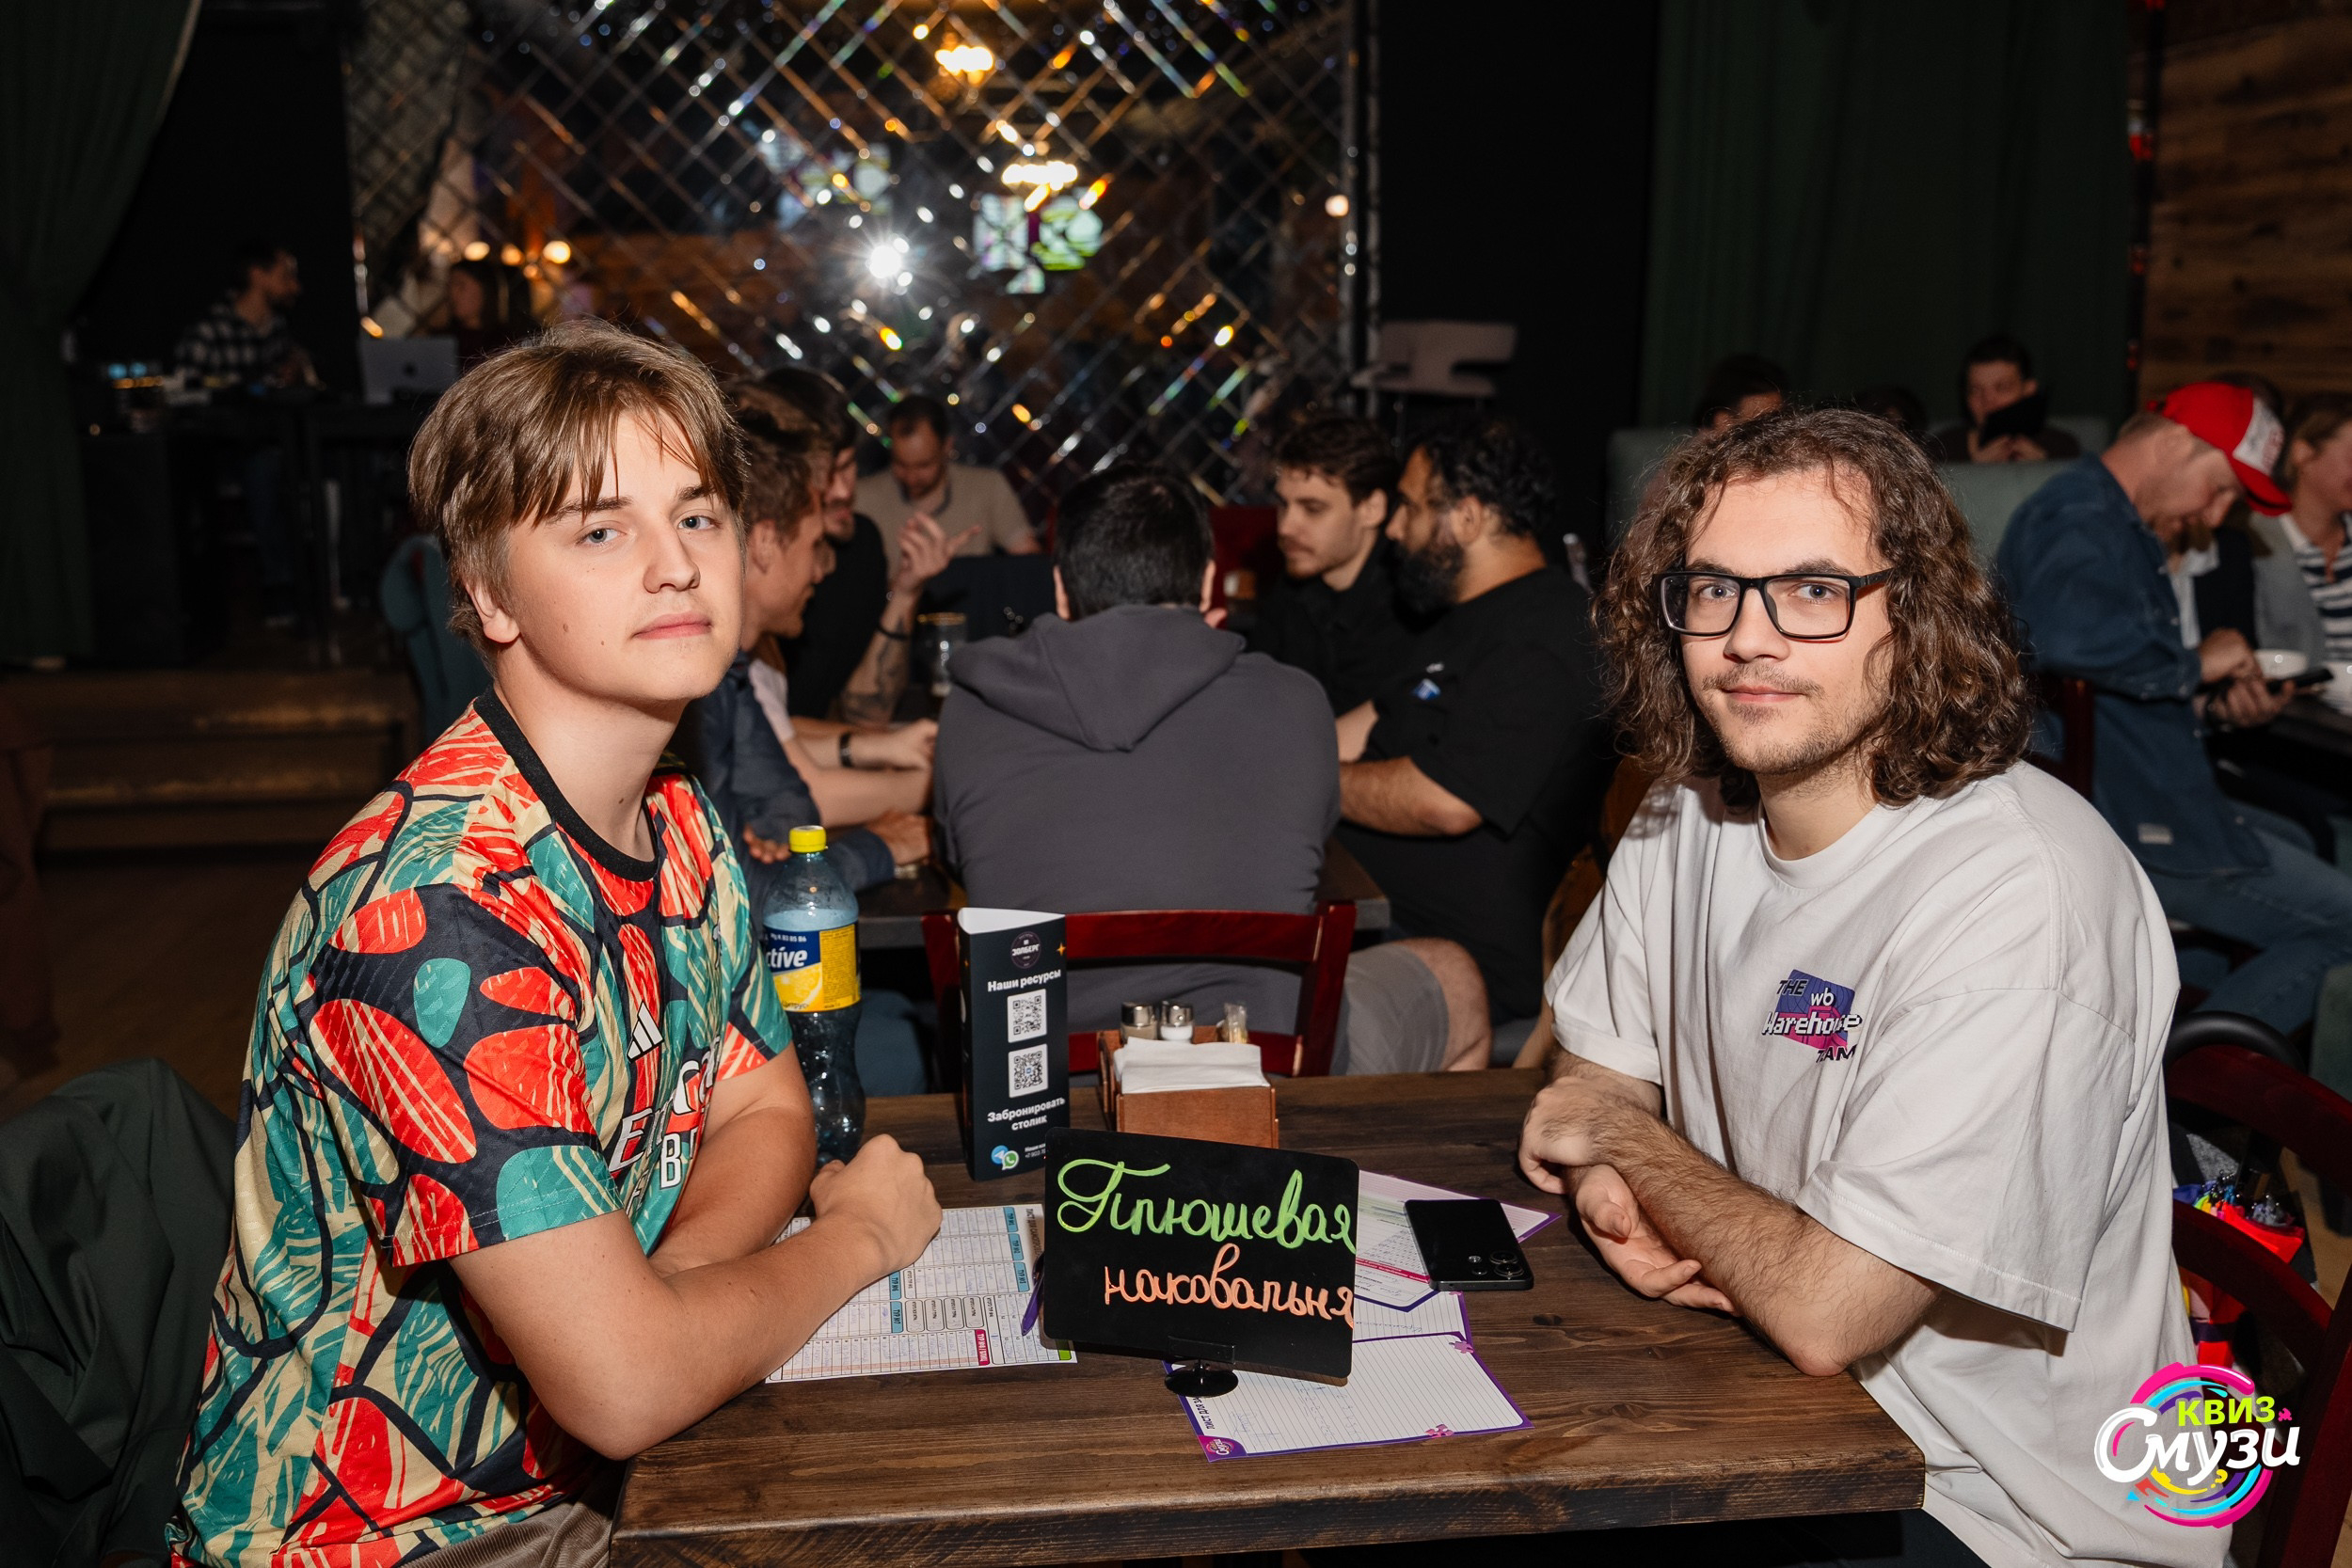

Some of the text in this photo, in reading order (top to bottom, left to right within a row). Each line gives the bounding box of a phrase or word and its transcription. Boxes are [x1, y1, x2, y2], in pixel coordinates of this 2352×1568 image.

[766, 946, 808, 969] ctive
[987, 969, 1061, 992] Наши ресурсы
[1776, 979, 1808, 996] THE
[1811, 988, 1836, 1006] wb
[1816, 1043, 1858, 1064] TAM
[987, 1097, 1066, 1122] Забронировать
[1011, 1115, 1048, 1131] столик
[1057, 1158, 1357, 1254] Плюшевая
